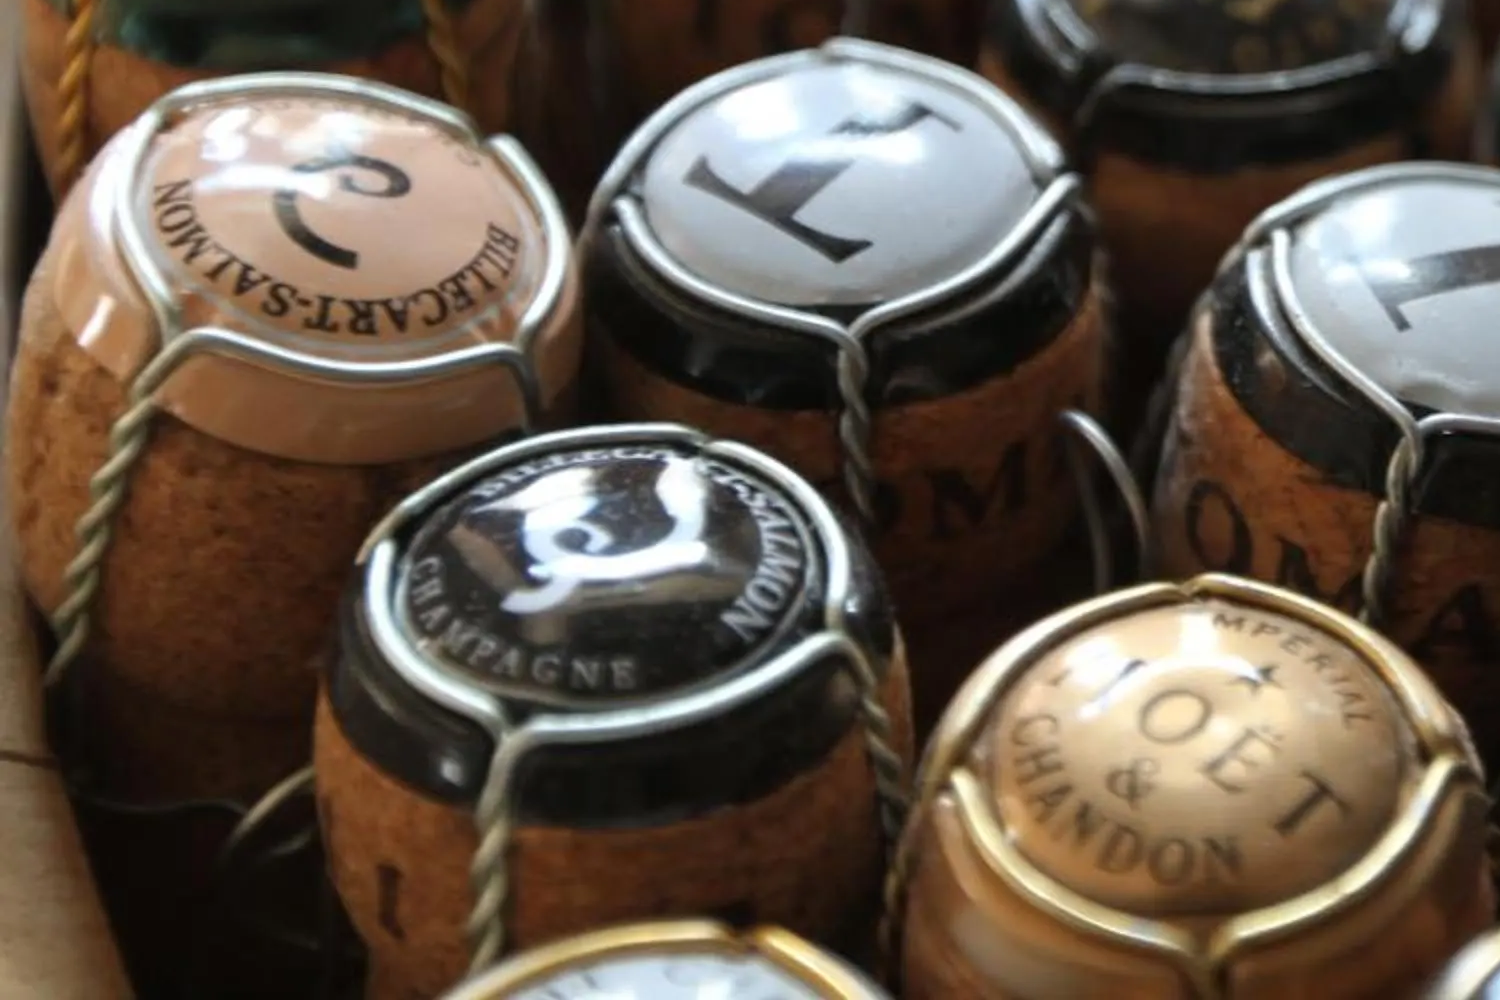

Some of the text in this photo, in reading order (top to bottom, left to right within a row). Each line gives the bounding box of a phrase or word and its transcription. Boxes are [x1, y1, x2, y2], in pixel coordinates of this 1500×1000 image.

[154, 179, 520, 336] BILLECART-SALMON
[682, 100, 965, 265] T
[411, 555, 640, 691] CHAMPAGNE
[1010, 712, 1246, 887] CHANDON
[1104, 756, 1161, 810] &
